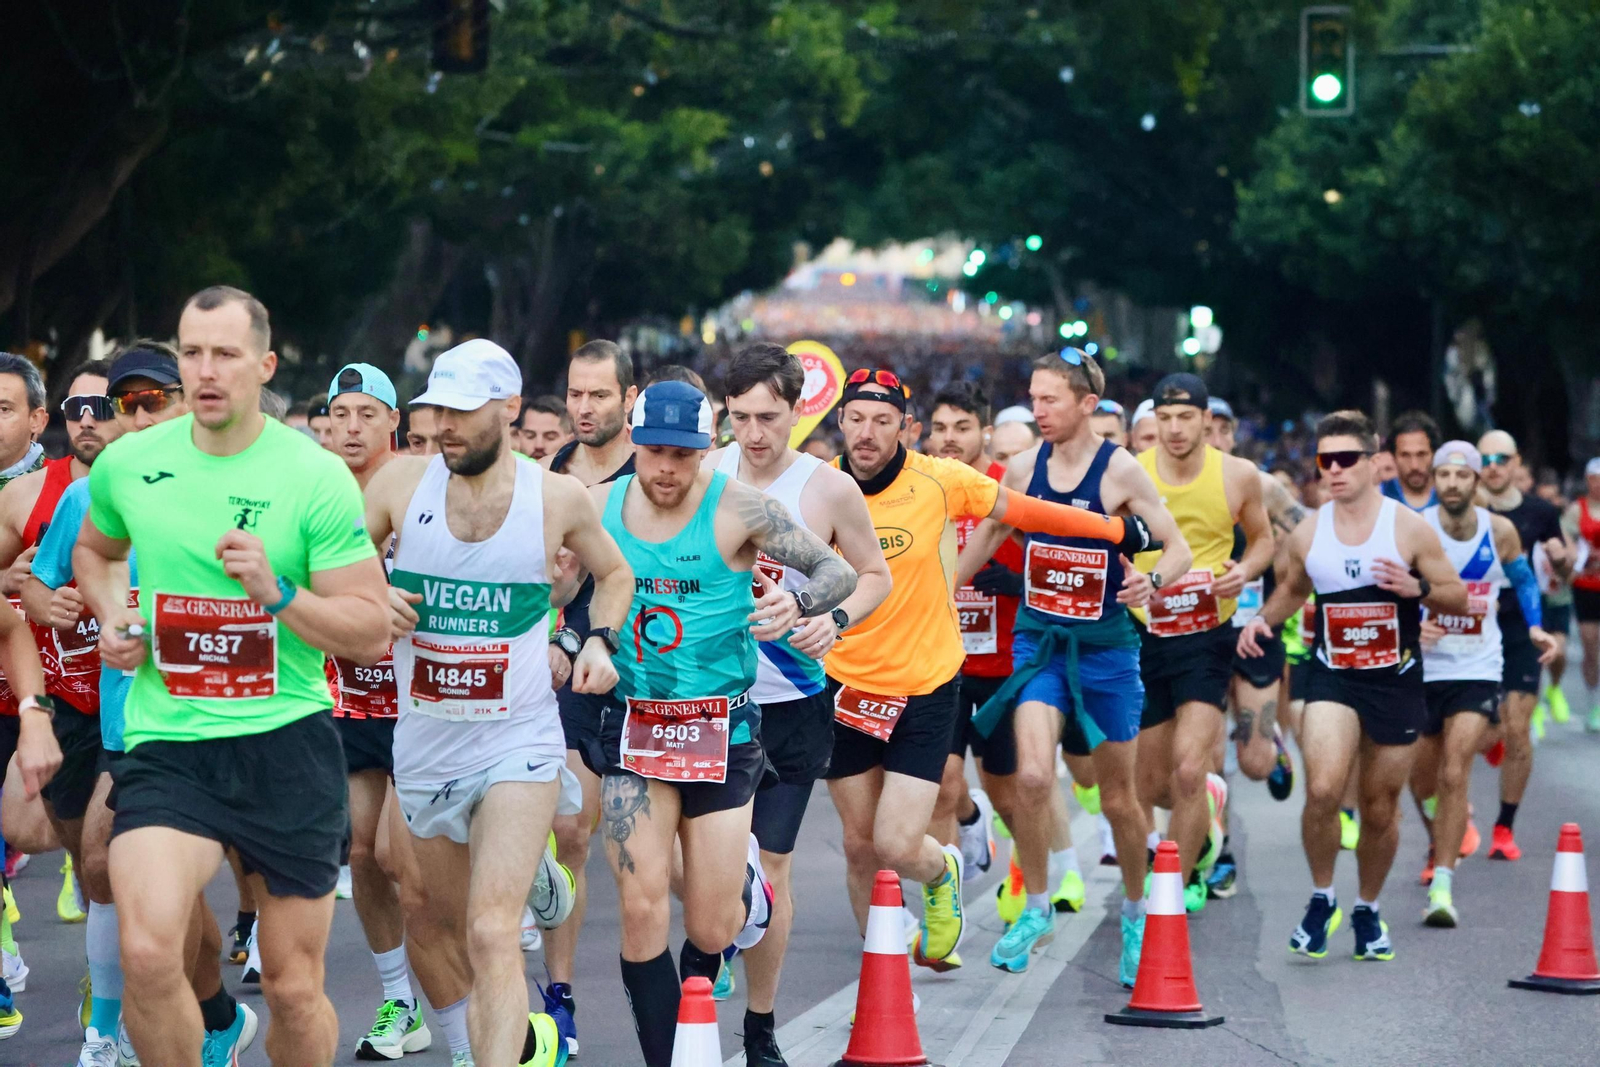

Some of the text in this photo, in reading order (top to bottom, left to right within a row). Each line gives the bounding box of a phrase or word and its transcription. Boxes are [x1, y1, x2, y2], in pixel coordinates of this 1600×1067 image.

[1048, 549, 1103, 565] GENERALI
[635, 577, 700, 594] PRESTON
[1046, 569, 1084, 588] 2016
[423, 579, 512, 613] VEGAN
[677, 595, 686, 603] 97
[1164, 592, 1199, 609] 3088
[186, 599, 266, 618] GENERALI
[428, 615, 499, 633] RUNNERS
[959, 611, 979, 625] 27
[1343, 627, 1379, 641] 3086
[184, 632, 243, 654] 7637
[199, 654, 230, 664] MICHAL
[355, 667, 394, 682] 5294
[426, 665, 486, 687] 14845
[655, 702, 721, 716] GENERALI
[858, 699, 899, 717] 5716
[859, 709, 891, 721] PALOMERO
[652, 724, 700, 742] 6503
[666, 741, 685, 749] MATT
